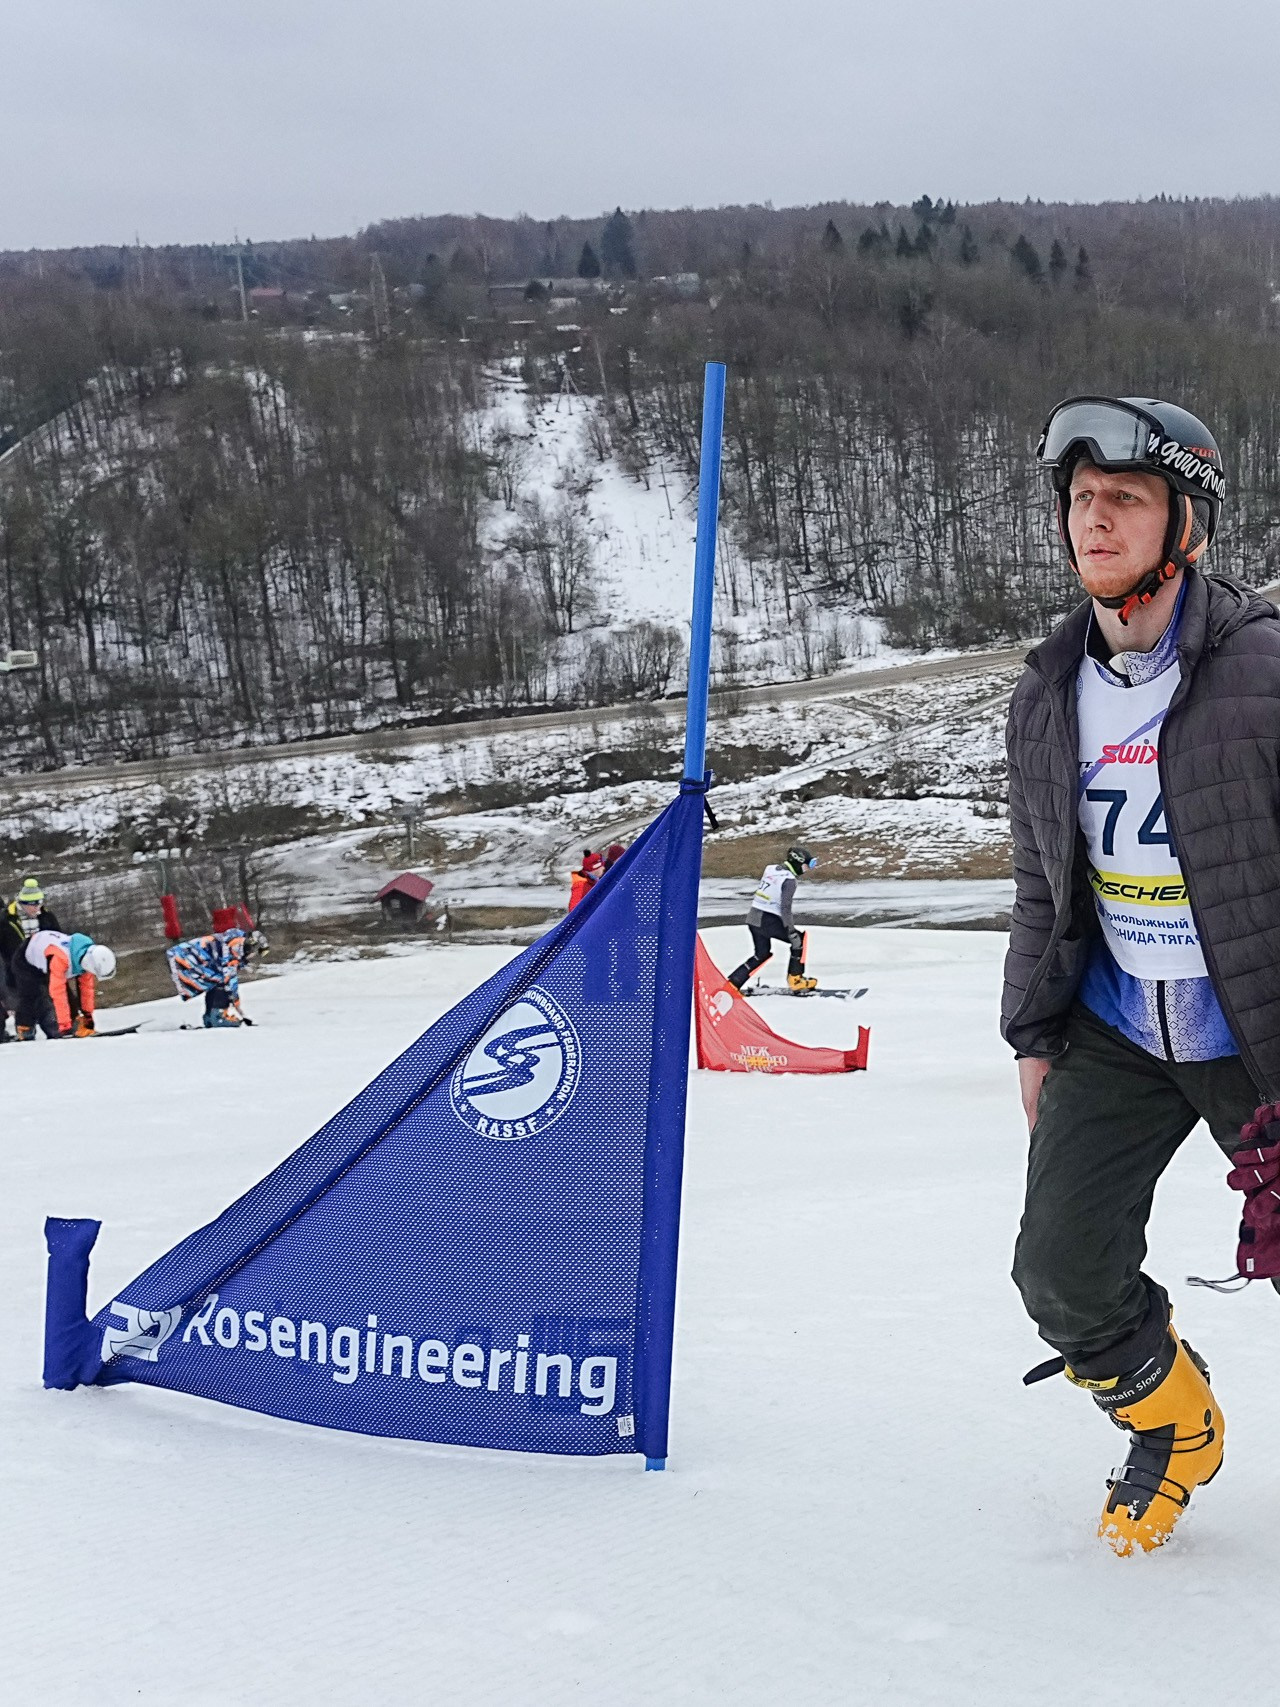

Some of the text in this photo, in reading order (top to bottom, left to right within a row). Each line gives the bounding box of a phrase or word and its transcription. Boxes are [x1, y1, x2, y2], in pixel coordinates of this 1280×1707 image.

[1086, 788, 1178, 858] 74
[1091, 874, 1188, 901] FISCHE
[1109, 912, 1189, 930] рнолыжный
[557, 1030, 577, 1102] FEDERATION
[476, 1116, 537, 1138] RASSF
[182, 1293, 618, 1417] Rosengineering
[1096, 1366, 1162, 1402] ountain Slope
